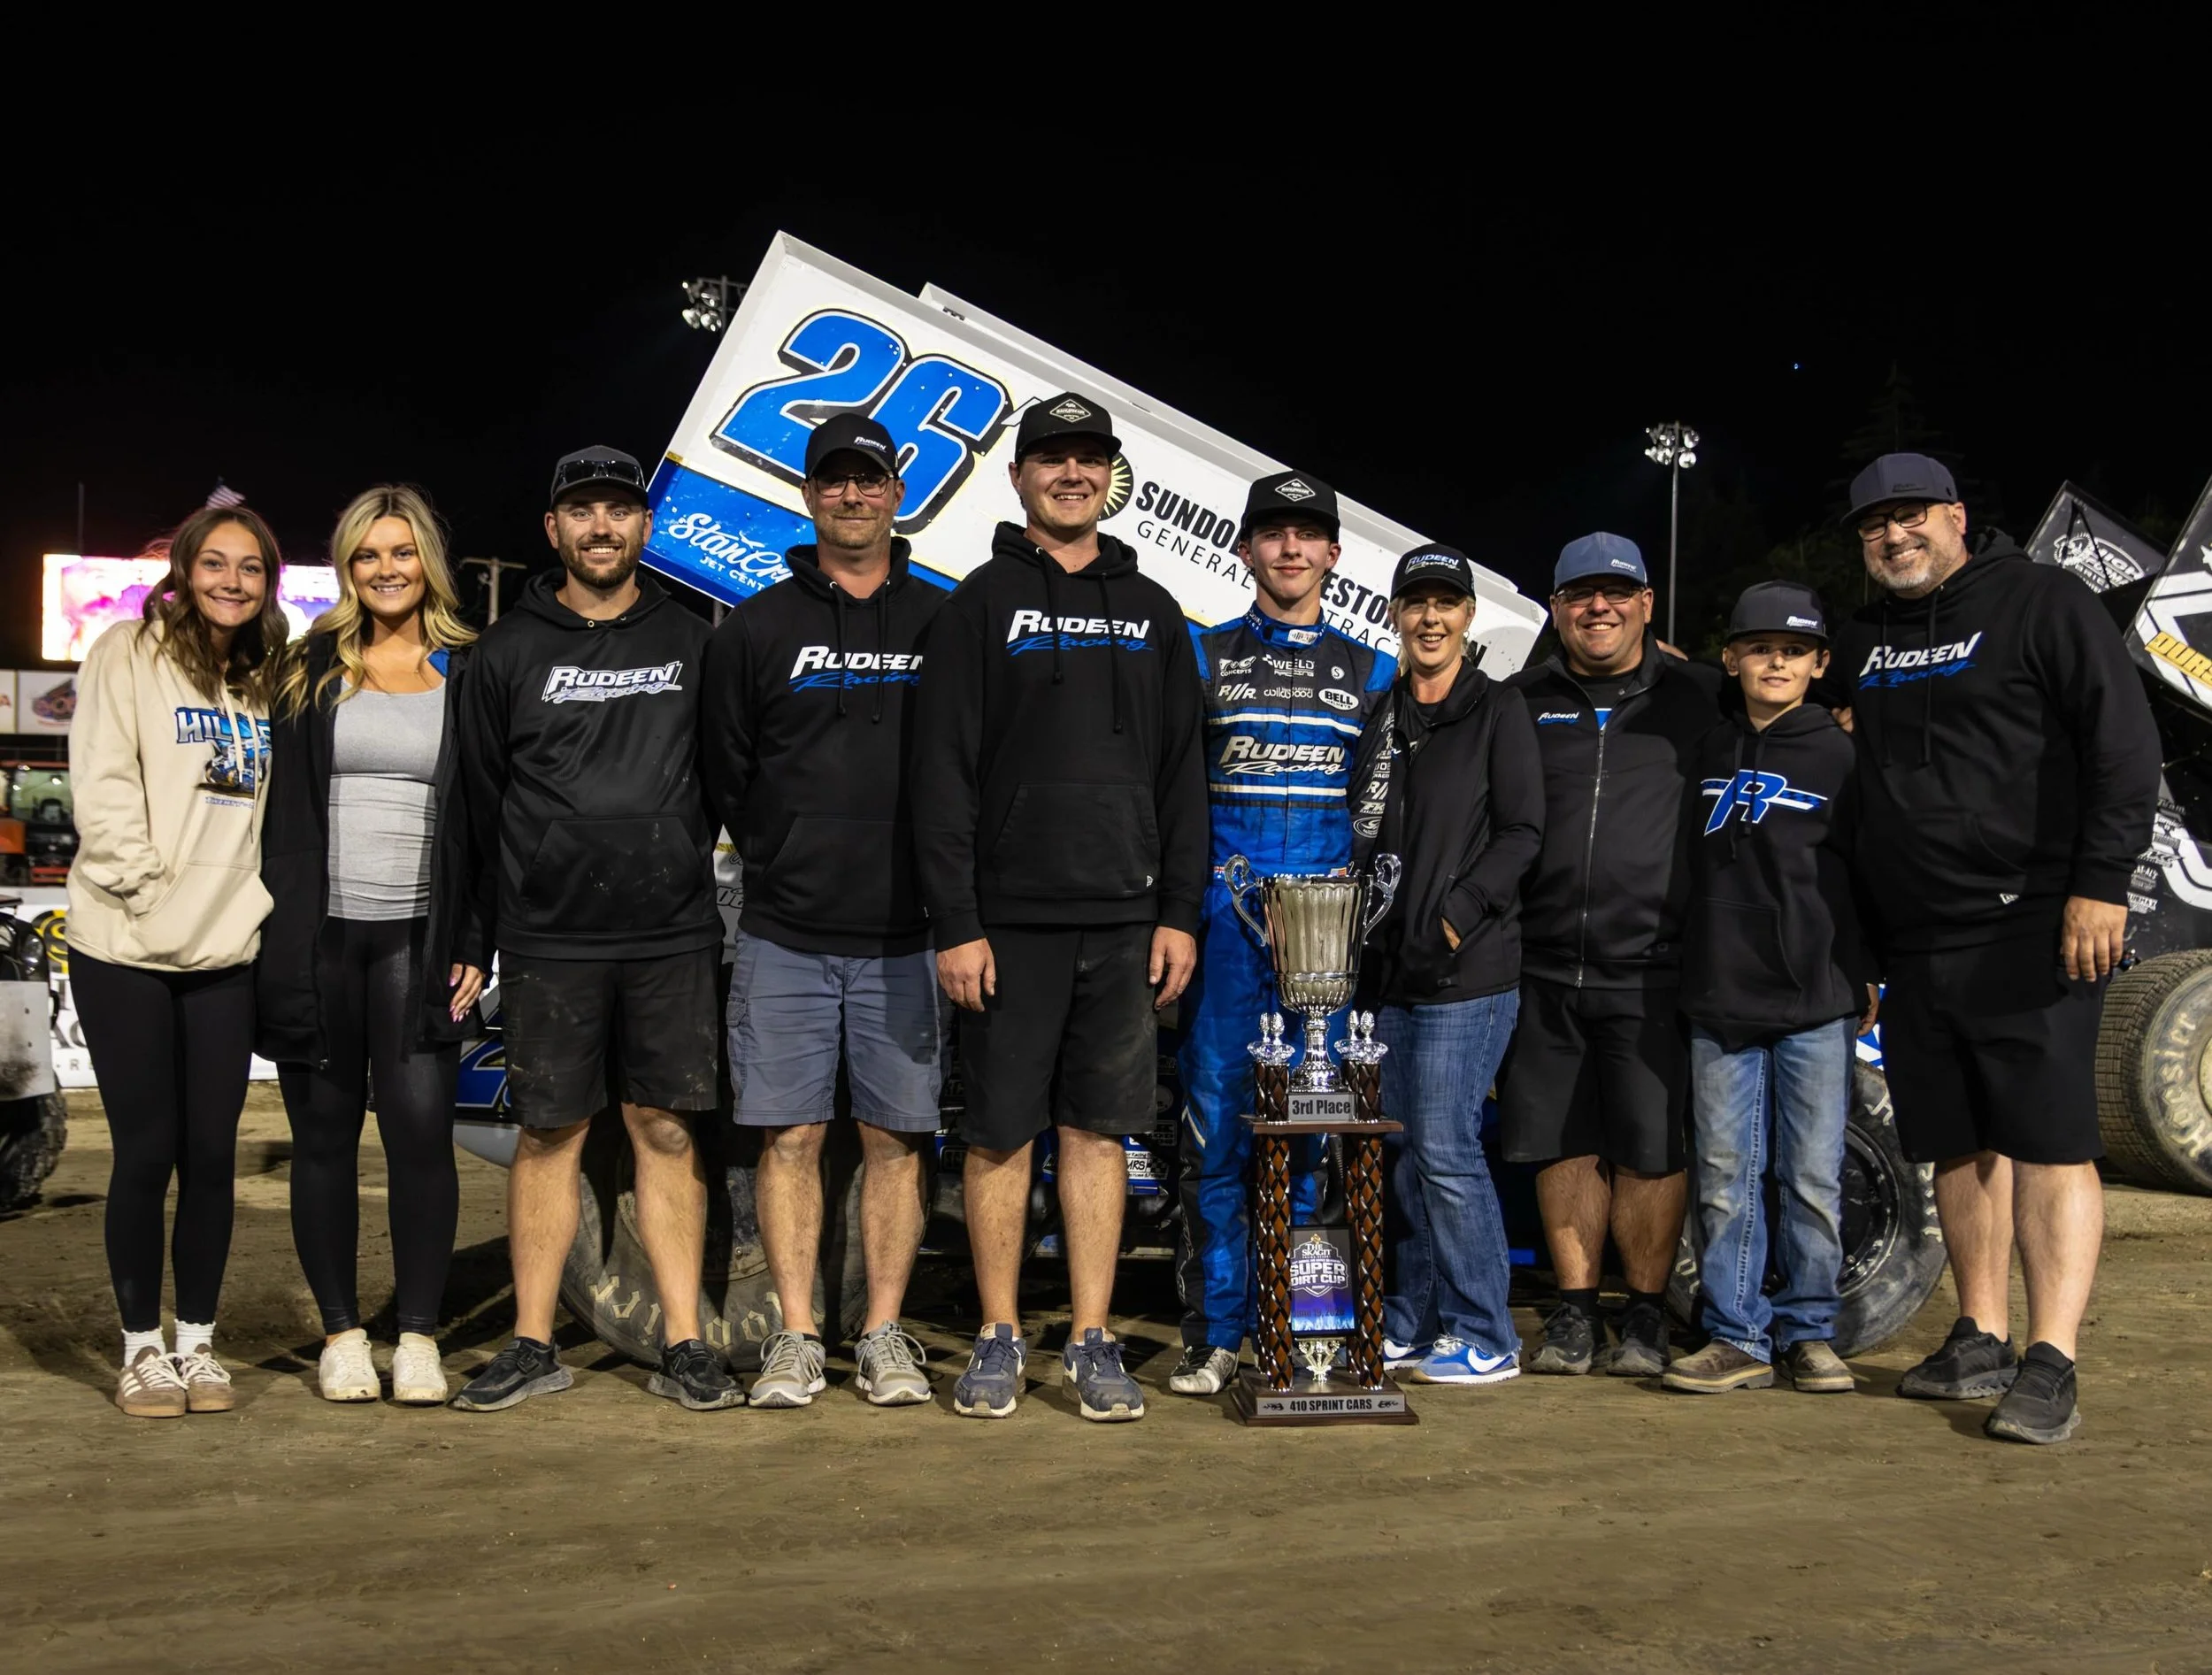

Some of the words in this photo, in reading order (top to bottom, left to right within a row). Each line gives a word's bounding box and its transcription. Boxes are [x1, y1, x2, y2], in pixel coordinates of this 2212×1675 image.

[709, 309, 1014, 534] 26
[700, 555, 726, 572] JET
[1007, 610, 1149, 643] RUDEEN
[1006, 634, 1154, 656] Racing
[1859, 631, 1982, 678] RUDEEN
[544, 662, 681, 697] RUDEEN
[1325, 690, 1354, 706] BELL
[1218, 735, 1345, 765] RUDEEN
[1223, 760, 1346, 777] Racing
[1292, 1099, 1313, 1115] 3rd
[1316, 1099, 1351, 1115] Place
[1290, 1262, 1346, 1276] SUPER
[1291, 1274, 1318, 1287] DIRT
[1321, 1274, 1346, 1284] CUP
[1289, 1401, 1307, 1411] 410
[1309, 1400, 1344, 1411] SPRINT
[1346, 1399, 1372, 1410] CARS
